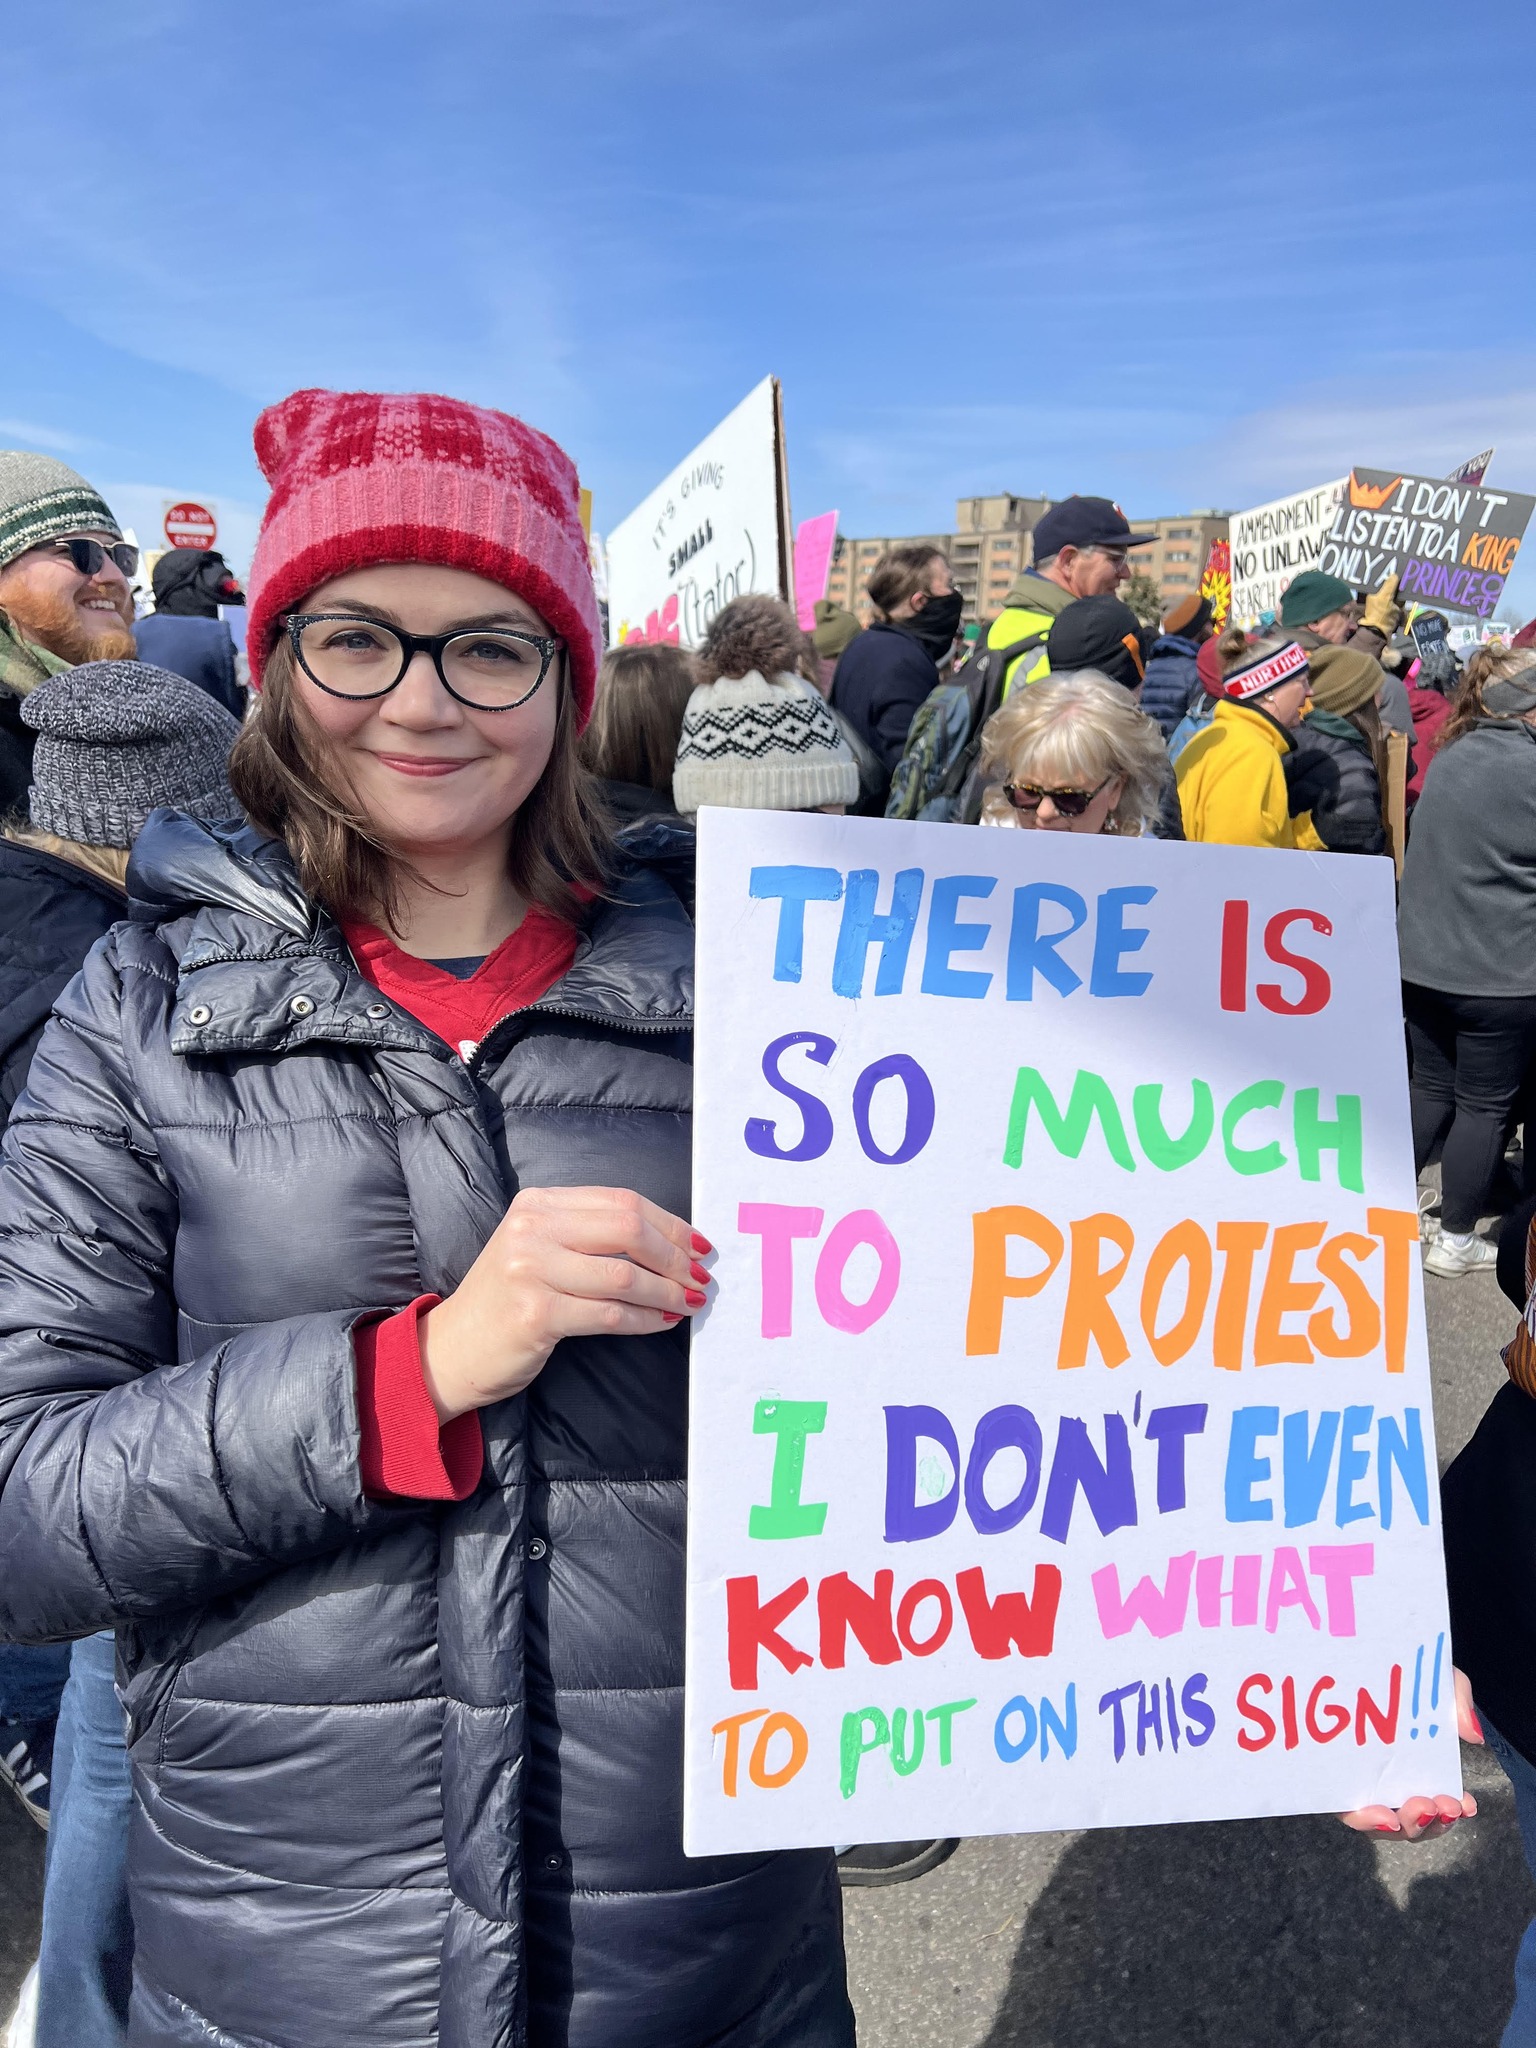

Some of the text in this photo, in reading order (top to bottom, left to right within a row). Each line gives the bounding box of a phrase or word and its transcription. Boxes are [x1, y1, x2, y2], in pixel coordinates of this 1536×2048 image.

[170, 510, 210, 522] DO NOT
[653, 461, 725, 550] IT'S GIVING
[1392, 478, 1415, 513] I
[1411, 481, 1508, 527] DON'T
[174, 534, 208, 547] ENTER
[669, 517, 713, 579] SMALL
[1234, 550, 1257, 582] NO
[1317, 542, 1483, 607] ONLY A PRINCE
[1328, 507, 1521, 575] LISTEN TO A KING
[1234, 579, 1276, 618] SEARCH
[749, 865, 1332, 1015] THERE IS
[745, 1032, 1365, 1193] SO MUCH
[738, 1203, 1419, 1373] TO PROTEST
[749, 1392, 1430, 1543] I DON'T EVEN
[726, 1543, 1375, 1690] KNOW WHAT
[712, 1632, 1445, 1799] TO PUT ON THIS SIGN!!
